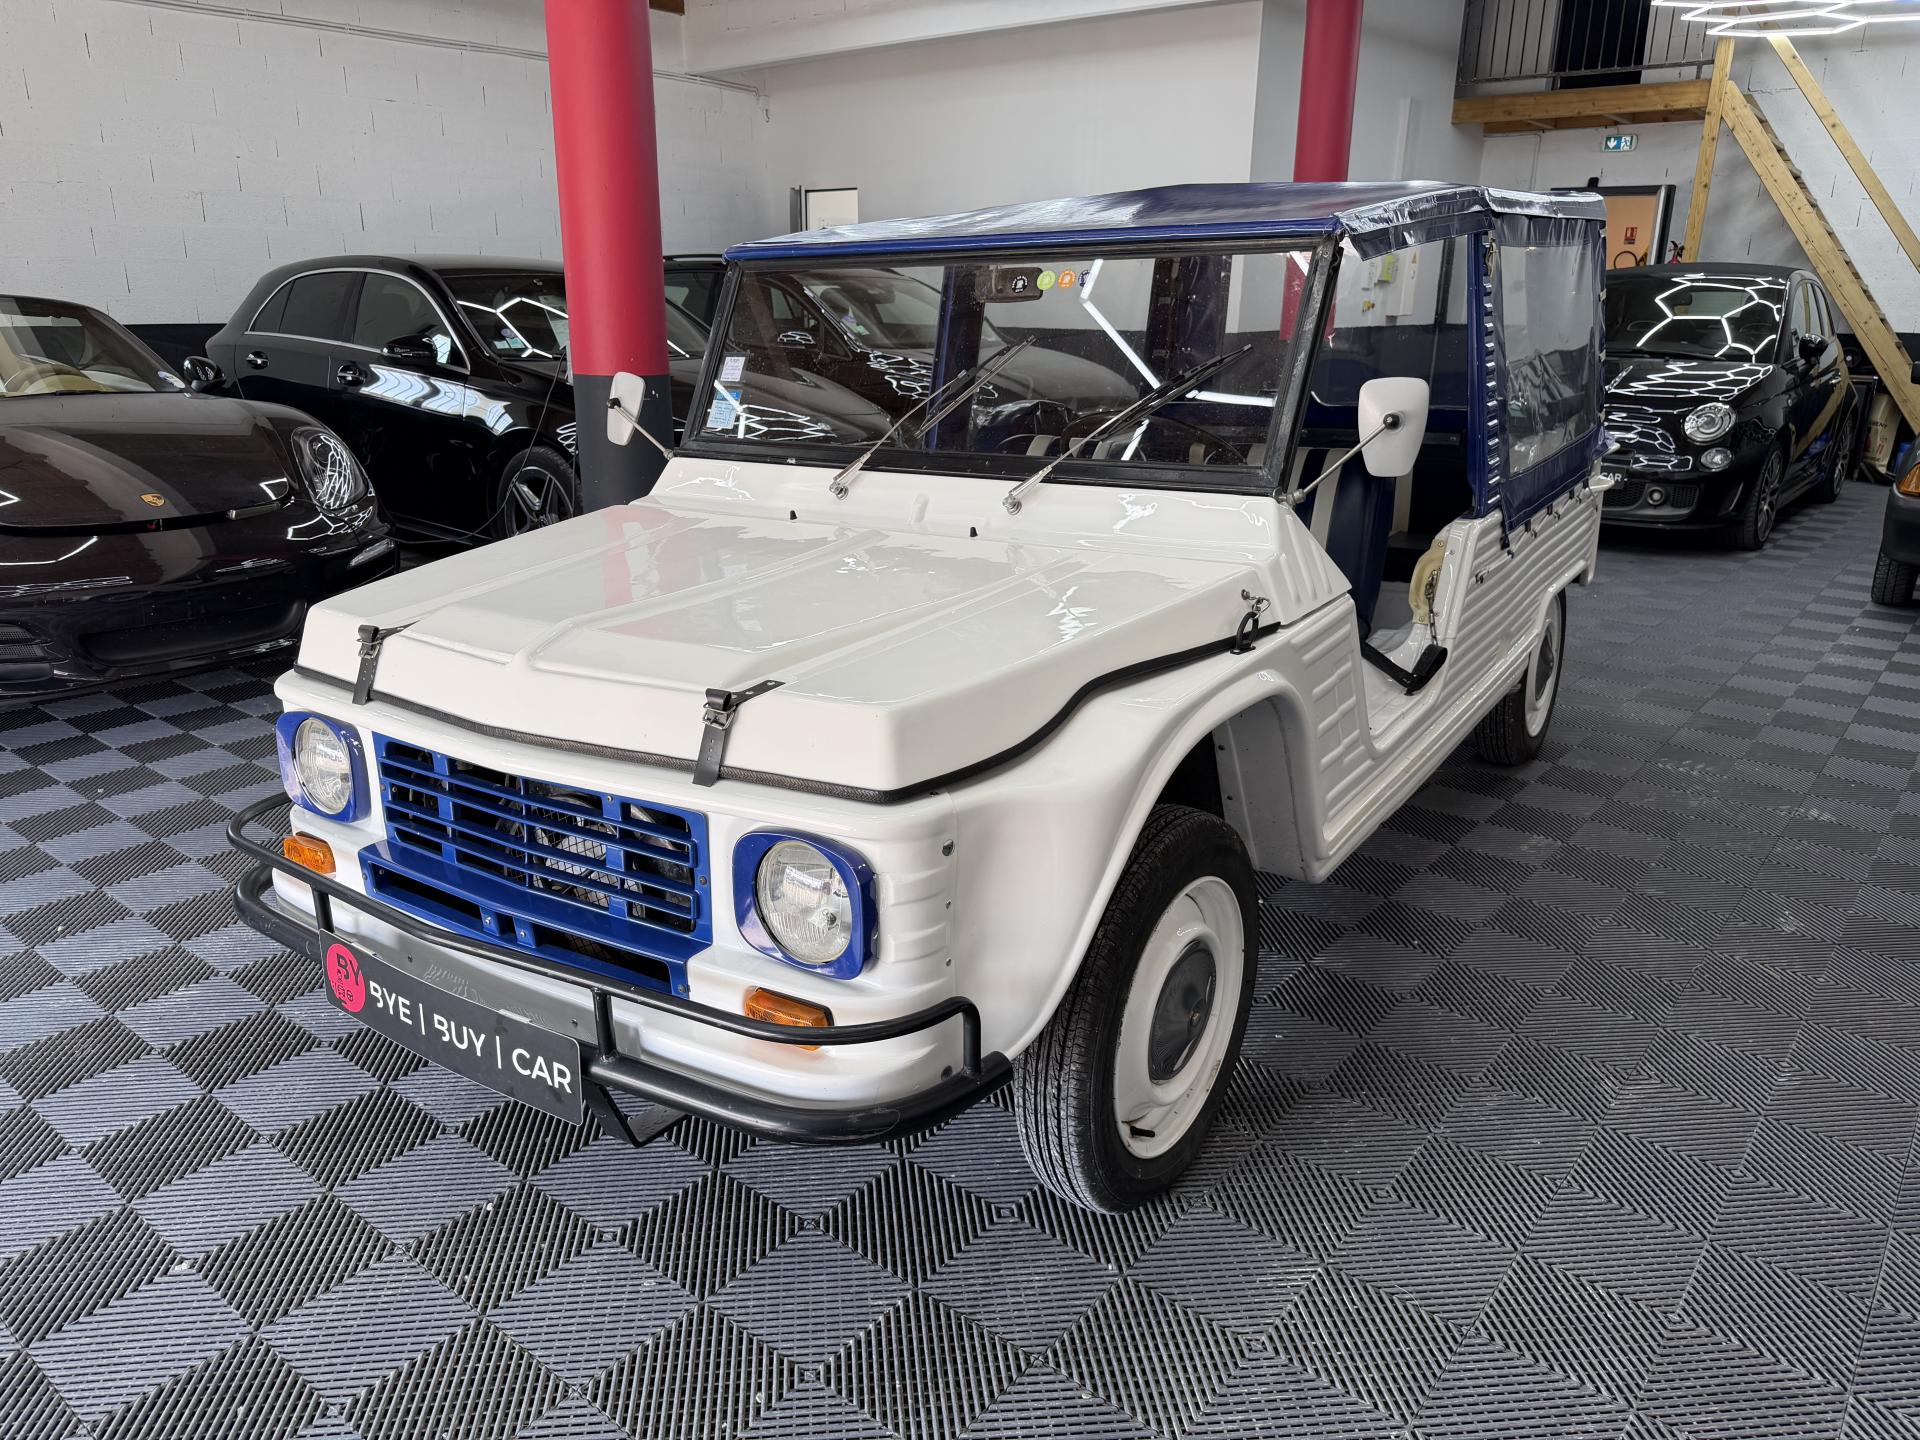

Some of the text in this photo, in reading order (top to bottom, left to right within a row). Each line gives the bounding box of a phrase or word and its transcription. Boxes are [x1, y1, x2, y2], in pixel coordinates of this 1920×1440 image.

[369, 980, 413, 1025] BYE
[433, 1013, 486, 1057] BUY
[511, 1047, 572, 1094] CAR
